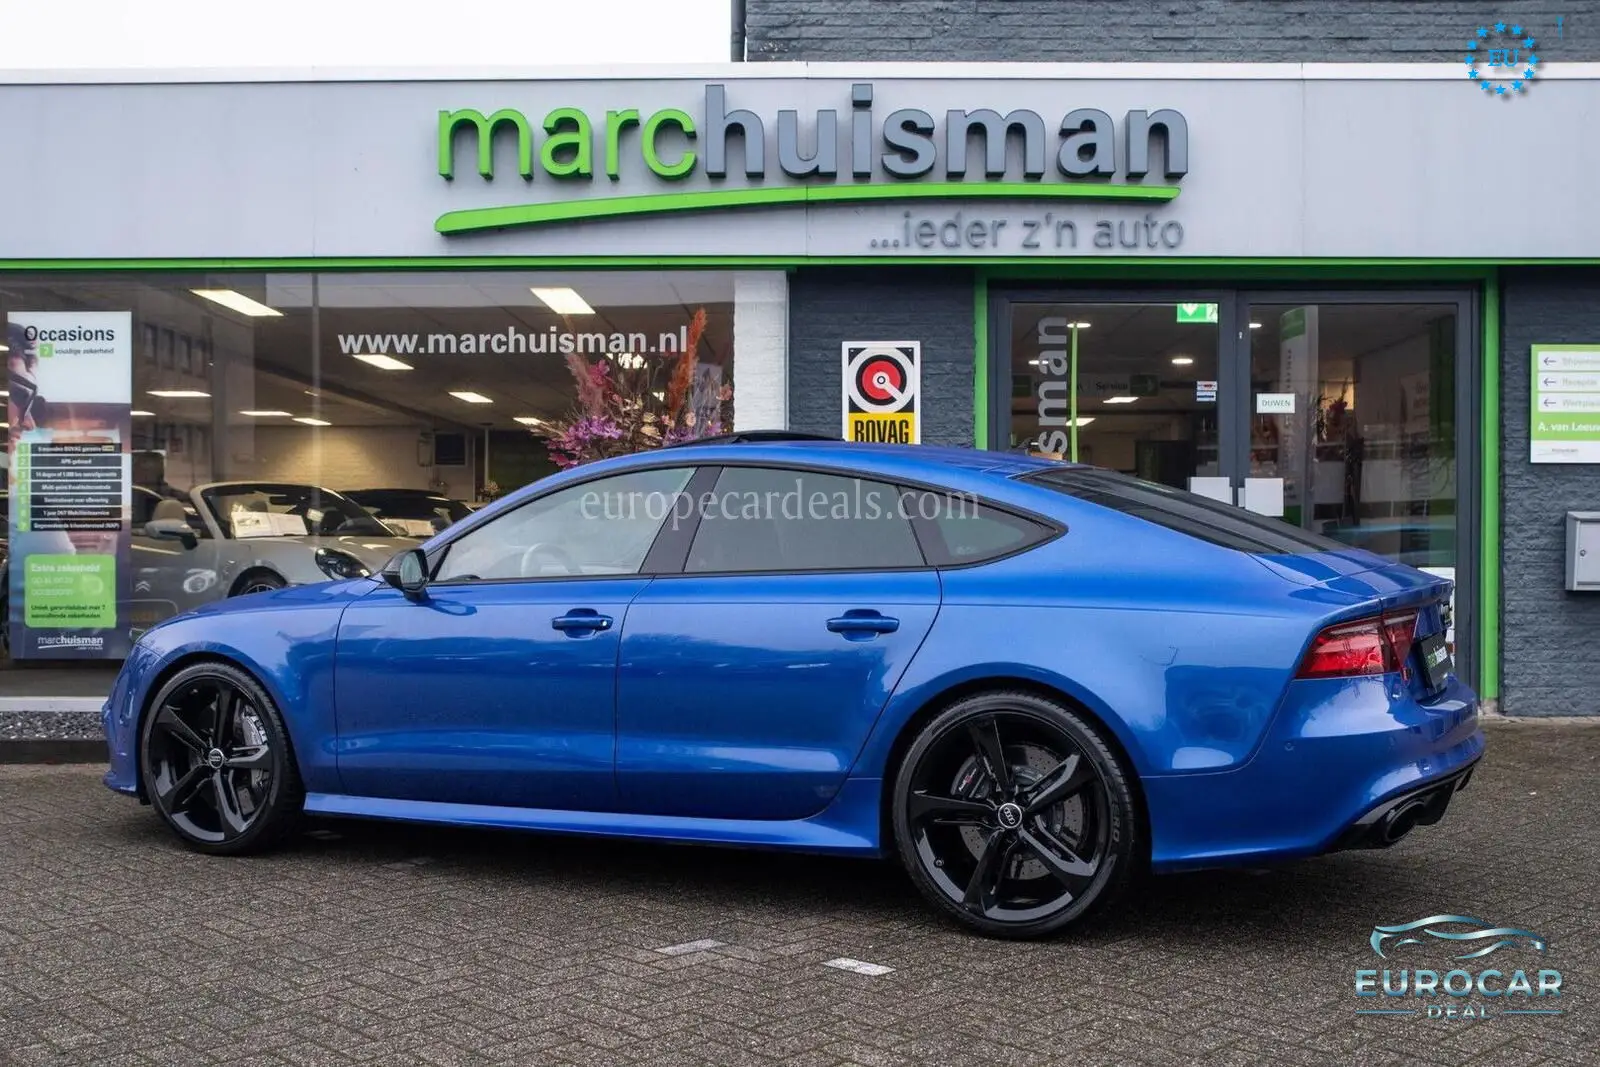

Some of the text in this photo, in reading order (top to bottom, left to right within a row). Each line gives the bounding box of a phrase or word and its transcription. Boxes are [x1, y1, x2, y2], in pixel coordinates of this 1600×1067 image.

[438, 84, 1188, 181] marchuisman
[1022, 213, 1077, 248] z'n
[1093, 214, 1184, 248] auto
[24, 325, 115, 341] Occasions
[338, 325, 687, 354] www.marchuisman.nl
[38, 635, 103, 645] marchuisman
